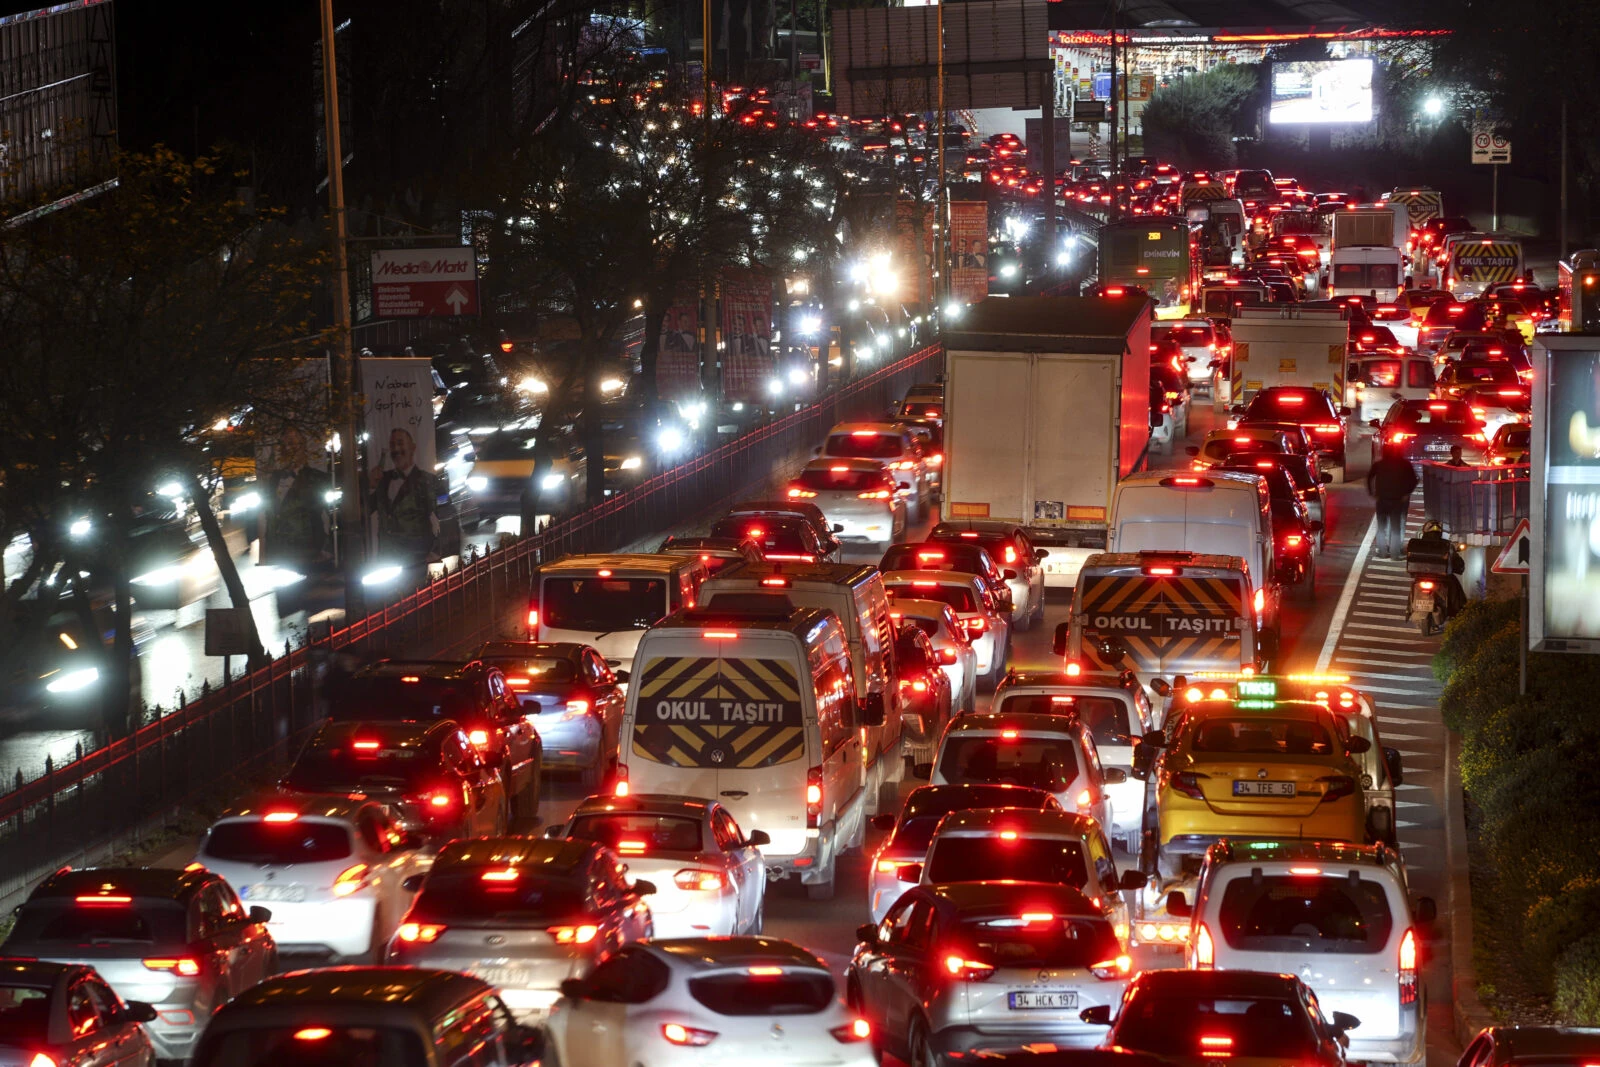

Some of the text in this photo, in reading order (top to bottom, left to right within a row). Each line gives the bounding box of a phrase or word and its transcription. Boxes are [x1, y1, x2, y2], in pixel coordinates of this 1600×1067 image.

[1478, 137, 1488, 145] 70
[1143, 249, 1180, 258] EMİNEVİM
[1460, 257, 1513, 267] OKUL TAŞITI
[1094, 616, 1231, 634] OKUL TAŞITI
[656, 700, 784, 725] OKUL TAŞITI
[1239, 783, 1293, 794] 34 TFE 50
[1017, 994, 1075, 1006] 34 HCK 197
